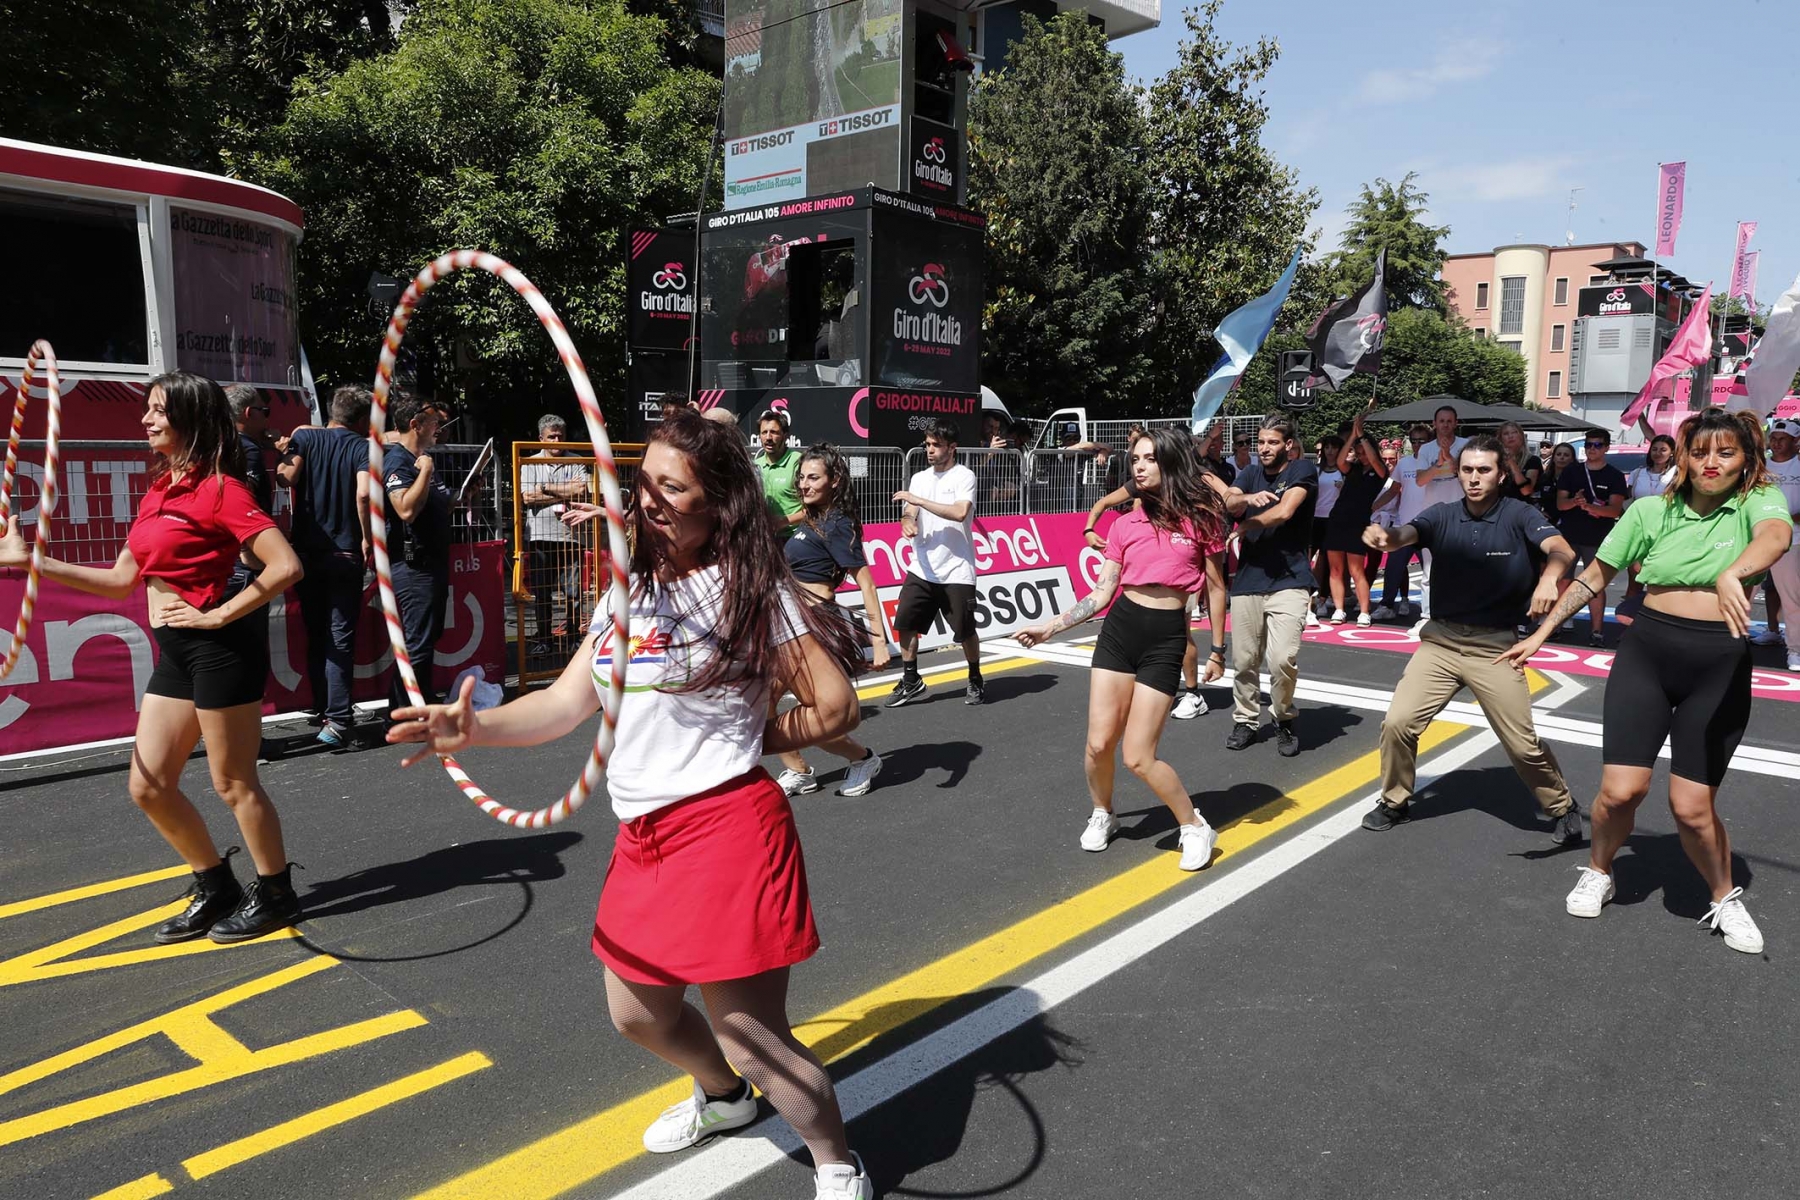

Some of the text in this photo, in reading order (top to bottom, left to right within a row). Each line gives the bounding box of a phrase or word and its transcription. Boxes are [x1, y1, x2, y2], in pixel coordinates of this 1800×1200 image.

[839, 109, 892, 133] TISSOT
[748, 130, 795, 152] TISSOT
[736, 175, 802, 196] Regione Emilia-Romagna
[915, 160, 930, 180] Giro
[930, 165, 952, 187] d'Italia
[708, 195, 855, 228] GIRO D'ITALIA 105 AMORE INFINITO
[874, 193, 893, 205] GIRO
[893, 198, 922, 213] D'ITALIA
[1661, 175, 1678, 243] LEONARDO
[181, 211, 231, 239] Gazzetta
[641, 291, 664, 312] Giro
[893, 307, 961, 346] Giro d'Italia
[186, 330, 236, 354] Gazzett
[920, 345, 935, 354] MAY
[935, 347, 952, 356] 2022
[876, 392, 976, 414] GIRODITALIA.IT
[972, 518, 1050, 571] enel
